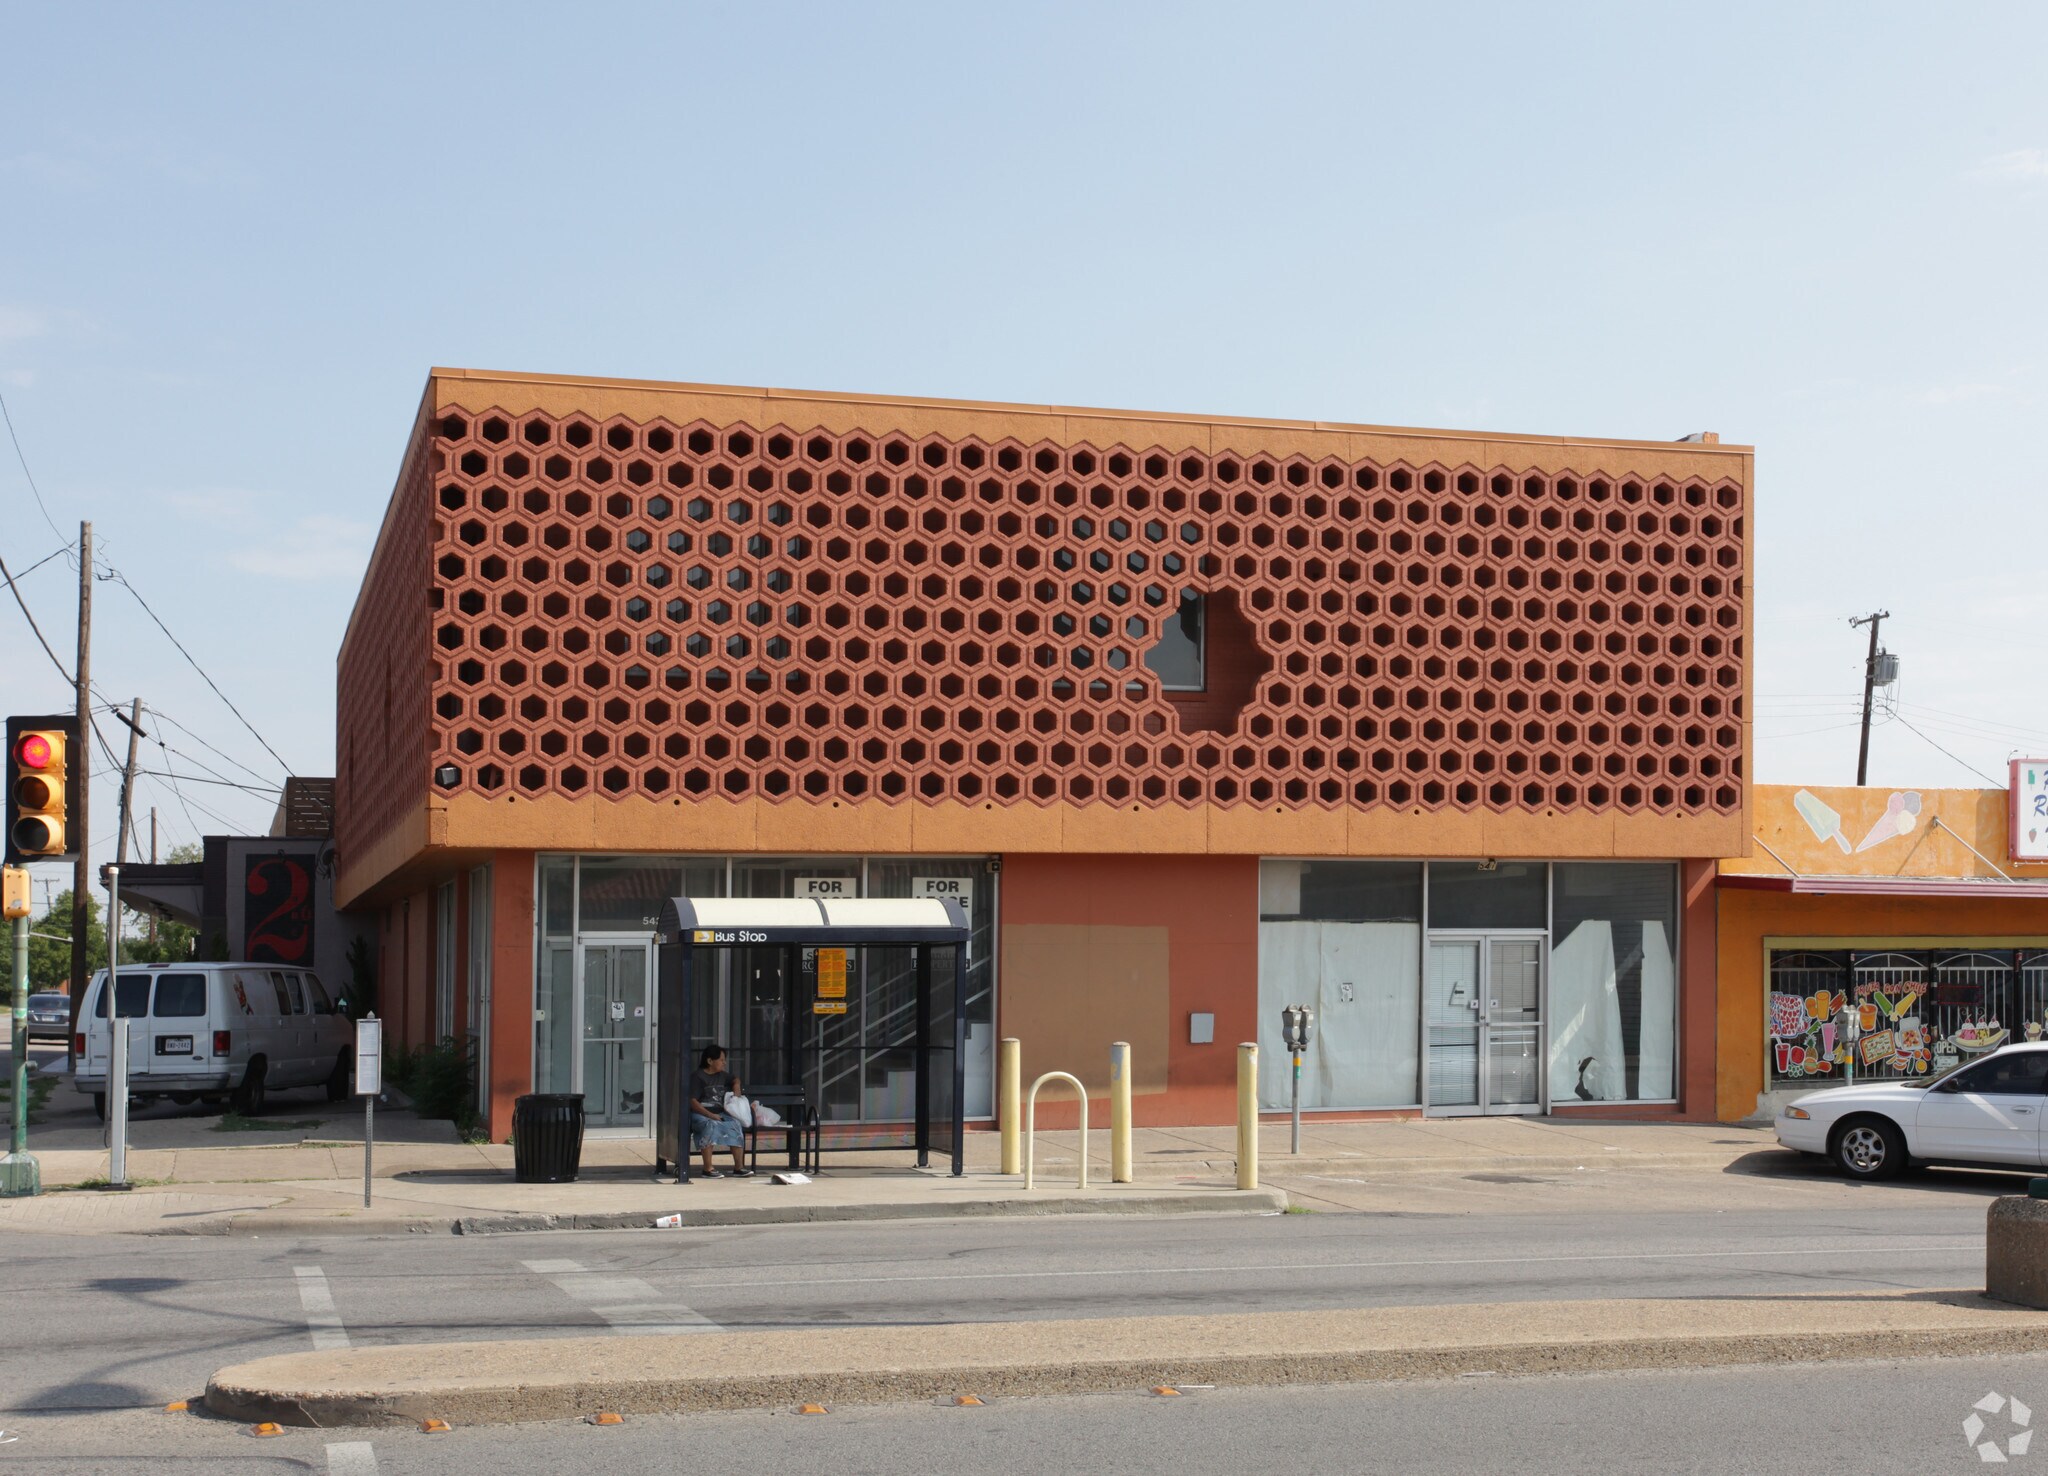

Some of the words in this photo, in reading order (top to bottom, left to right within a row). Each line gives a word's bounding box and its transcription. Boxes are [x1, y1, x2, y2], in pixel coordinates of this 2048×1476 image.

[2033, 794, 2048, 817] R
[808, 880, 842, 893] FOR
[926, 880, 959, 893] FOR
[715, 931, 735, 942] Bus
[738, 930, 768, 942] Stop
[1903, 981, 1928, 996] CHILE
[1936, 1041, 1957, 1053] OPEN
